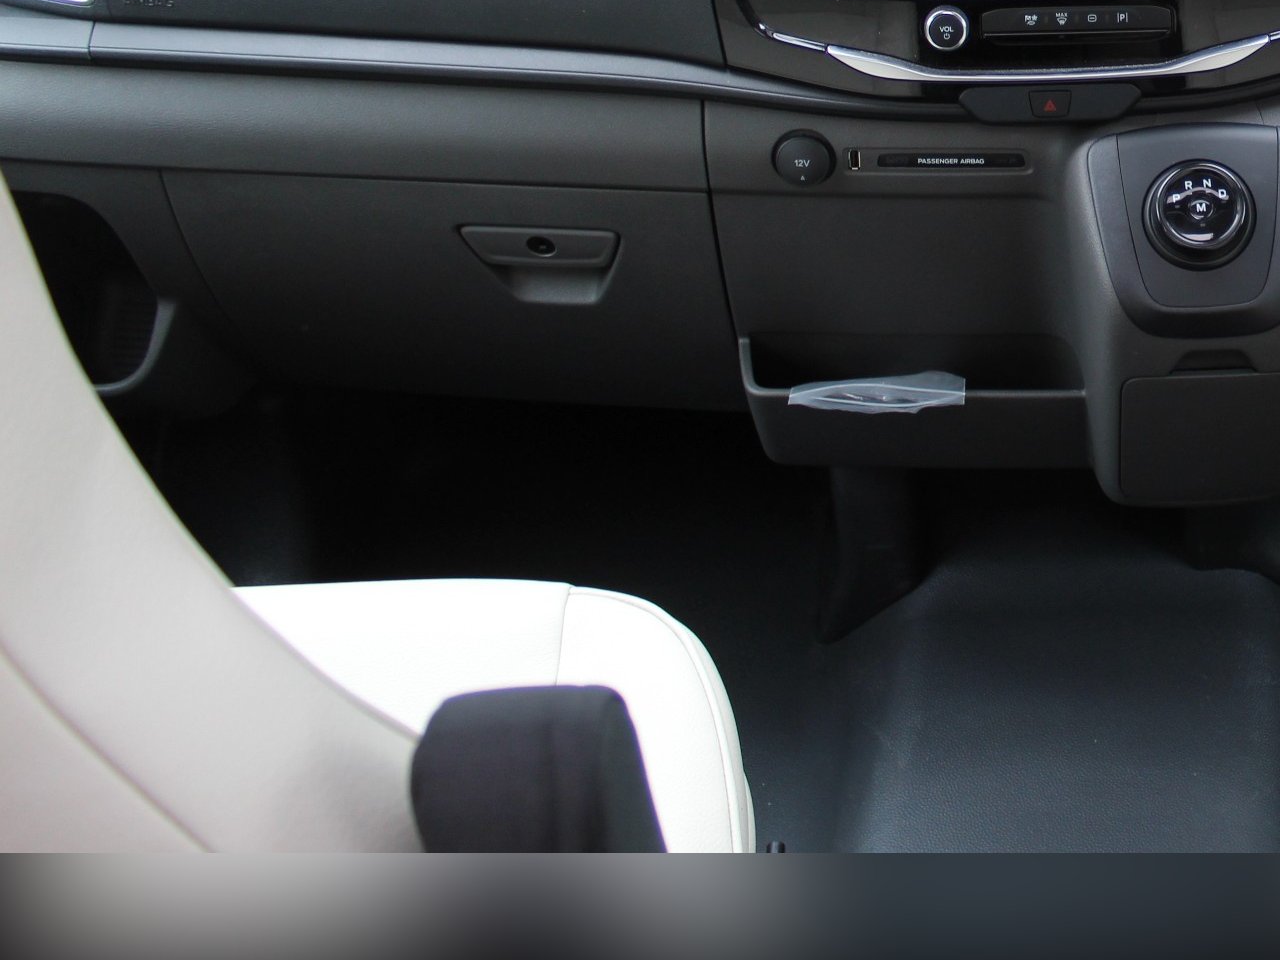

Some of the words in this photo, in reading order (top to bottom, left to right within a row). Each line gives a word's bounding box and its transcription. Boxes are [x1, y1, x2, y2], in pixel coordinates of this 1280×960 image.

[794, 159, 811, 167] 12V
[1172, 194, 1180, 203] P
[1184, 180, 1193, 190] R
[1203, 179, 1212, 188] N
[1218, 189, 1227, 198] D
[1196, 203, 1207, 212] M
